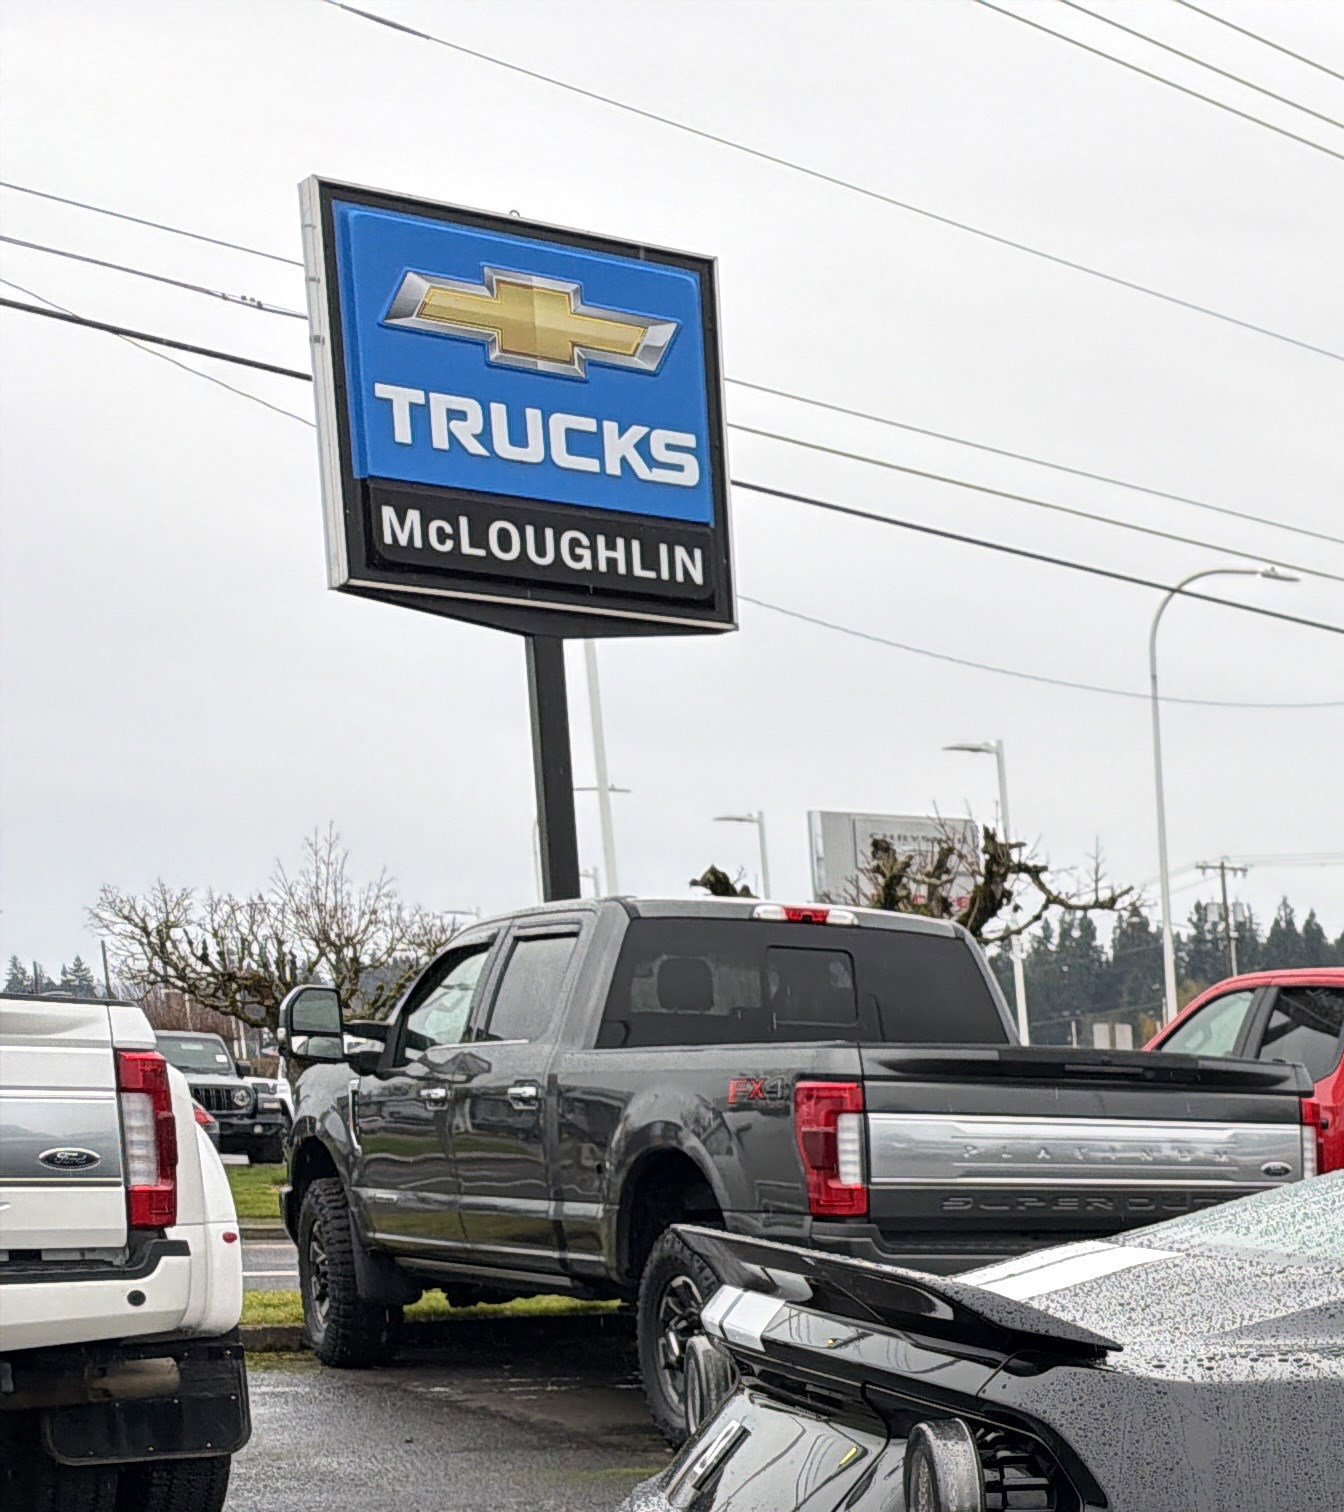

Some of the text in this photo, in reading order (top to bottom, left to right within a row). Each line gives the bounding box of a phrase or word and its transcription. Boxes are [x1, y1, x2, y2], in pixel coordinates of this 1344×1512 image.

[373, 383, 700, 487] TRUCKS
[382, 504, 704, 586] McLOUGHLIN
[728, 1076, 783, 1104] FX4
[942, 1197, 1114, 1211] SUPER
